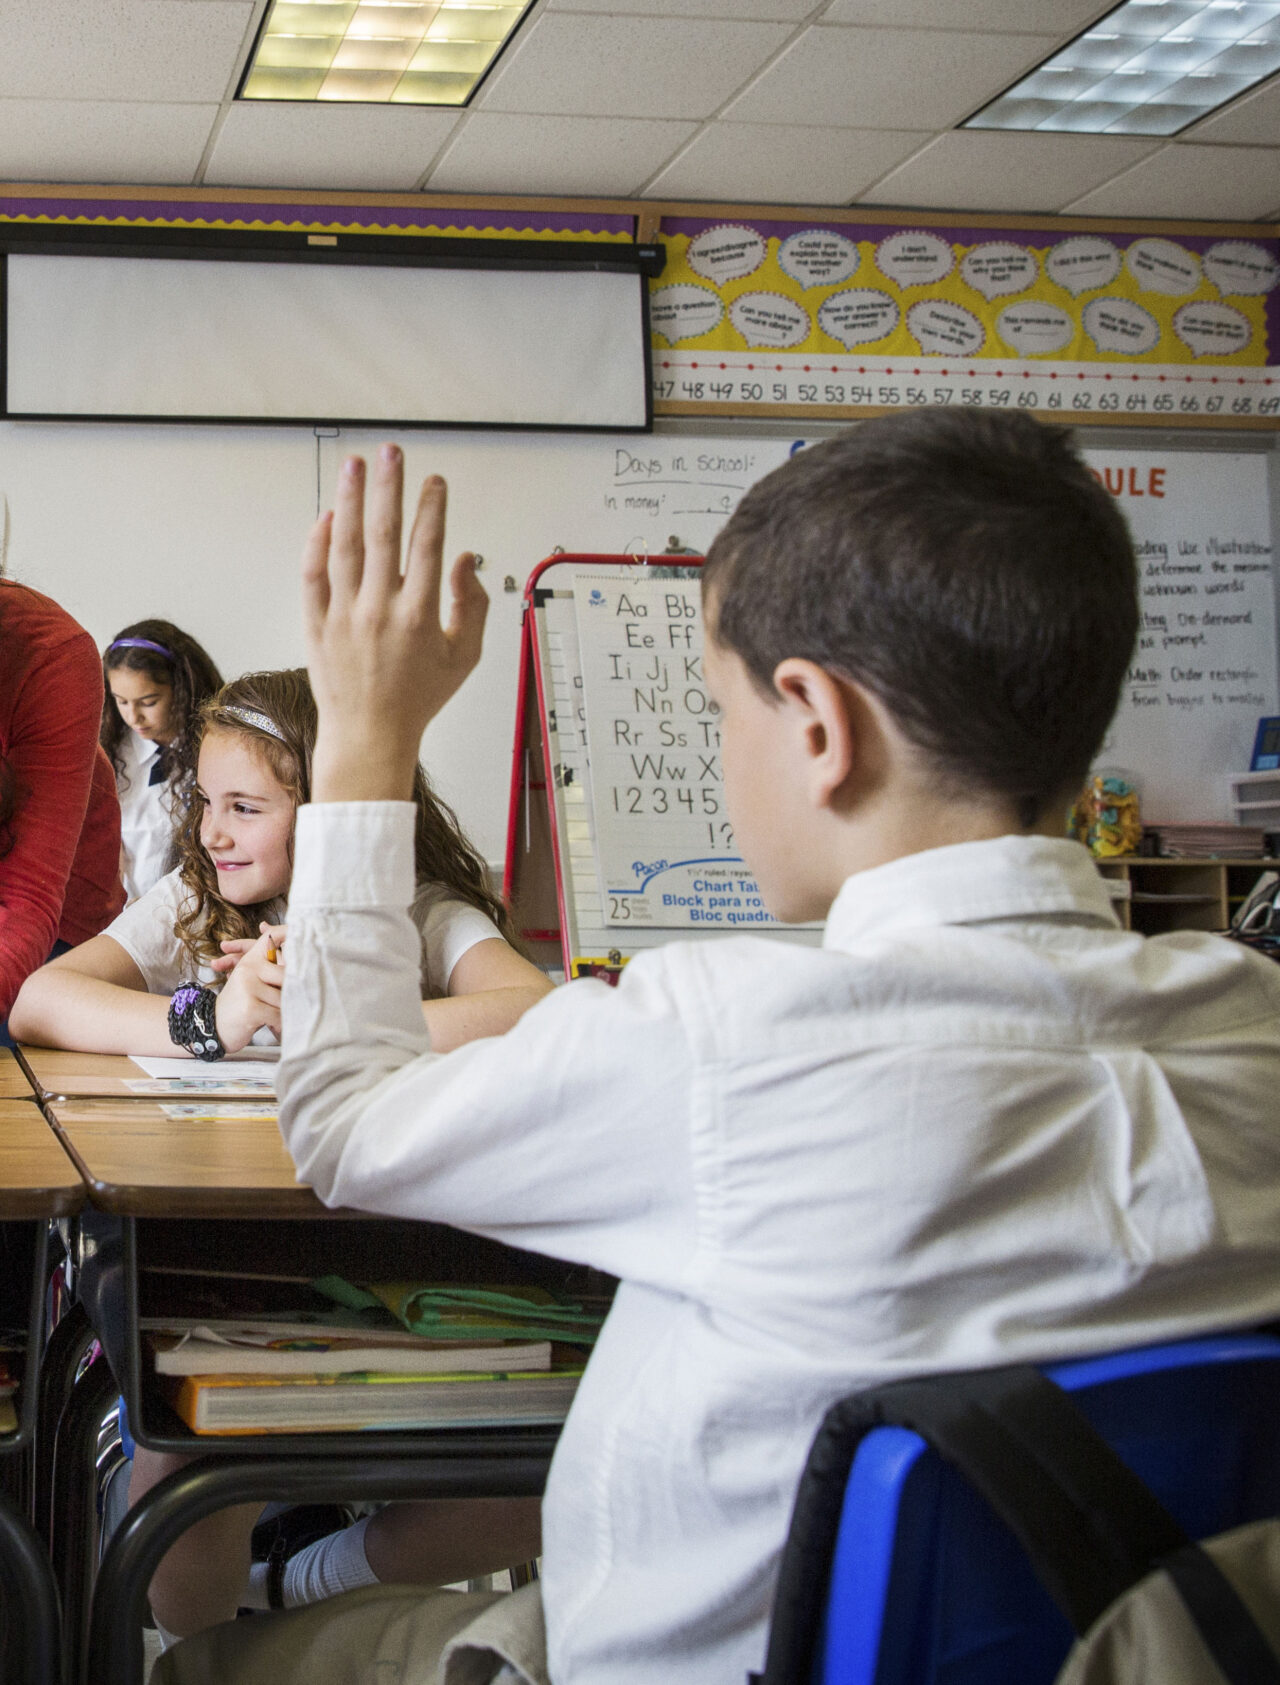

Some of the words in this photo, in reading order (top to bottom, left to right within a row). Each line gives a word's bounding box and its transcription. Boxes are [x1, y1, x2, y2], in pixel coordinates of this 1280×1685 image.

[682, 382, 705, 399] 48
[710, 383, 733, 399] 49
[740, 383, 763, 400] 50
[772, 384, 787, 400] 51
[798, 385, 818, 401] 52
[824, 385, 845, 402] 53
[850, 386, 872, 402] 54
[878, 387, 899, 404] 55
[905, 387, 927, 404] 56
[933, 388, 954, 405] 57
[961, 389, 982, 406] 58
[989, 390, 1011, 406] 59
[1017, 391, 1038, 407] 60
[1048, 392, 1062, 408] 61
[1072, 392, 1091, 409] 62
[1099, 393, 1119, 410] 63
[1126, 393, 1147, 410] 64
[1153, 394, 1173, 411] 65
[1180, 395, 1200, 411] 66
[1205, 395, 1224, 412] 67
[1231, 396, 1251, 413] 68
[614, 449, 662, 476] Days
[671, 455, 688, 472] in
[616, 593, 648, 617] Aa
[664, 594, 696, 618] Bb
[626, 623, 655, 648] Ee
[668, 624, 696, 649] Ff
[646, 655, 669, 692] Jj
[683, 657, 703, 681] K
[634, 688, 673, 713] Nn
[684, 689, 720, 715] Oo
[614, 720, 644, 746] Rr
[659, 721, 687, 748] Ss
[631, 753, 687, 781] Ww
[698, 755, 723, 782] X
[626, 787, 644, 813] 2
[652, 787, 669, 813] 3
[677, 788, 694, 814] 4
[702, 788, 719, 815] 5
[631, 859, 669, 878] Pacon
[693, 879, 733, 892] Chart
[609, 898, 631, 920] 25
[662, 894, 703, 907] Block
[709, 897, 739, 910] para
[690, 908, 723, 921] Bloc
